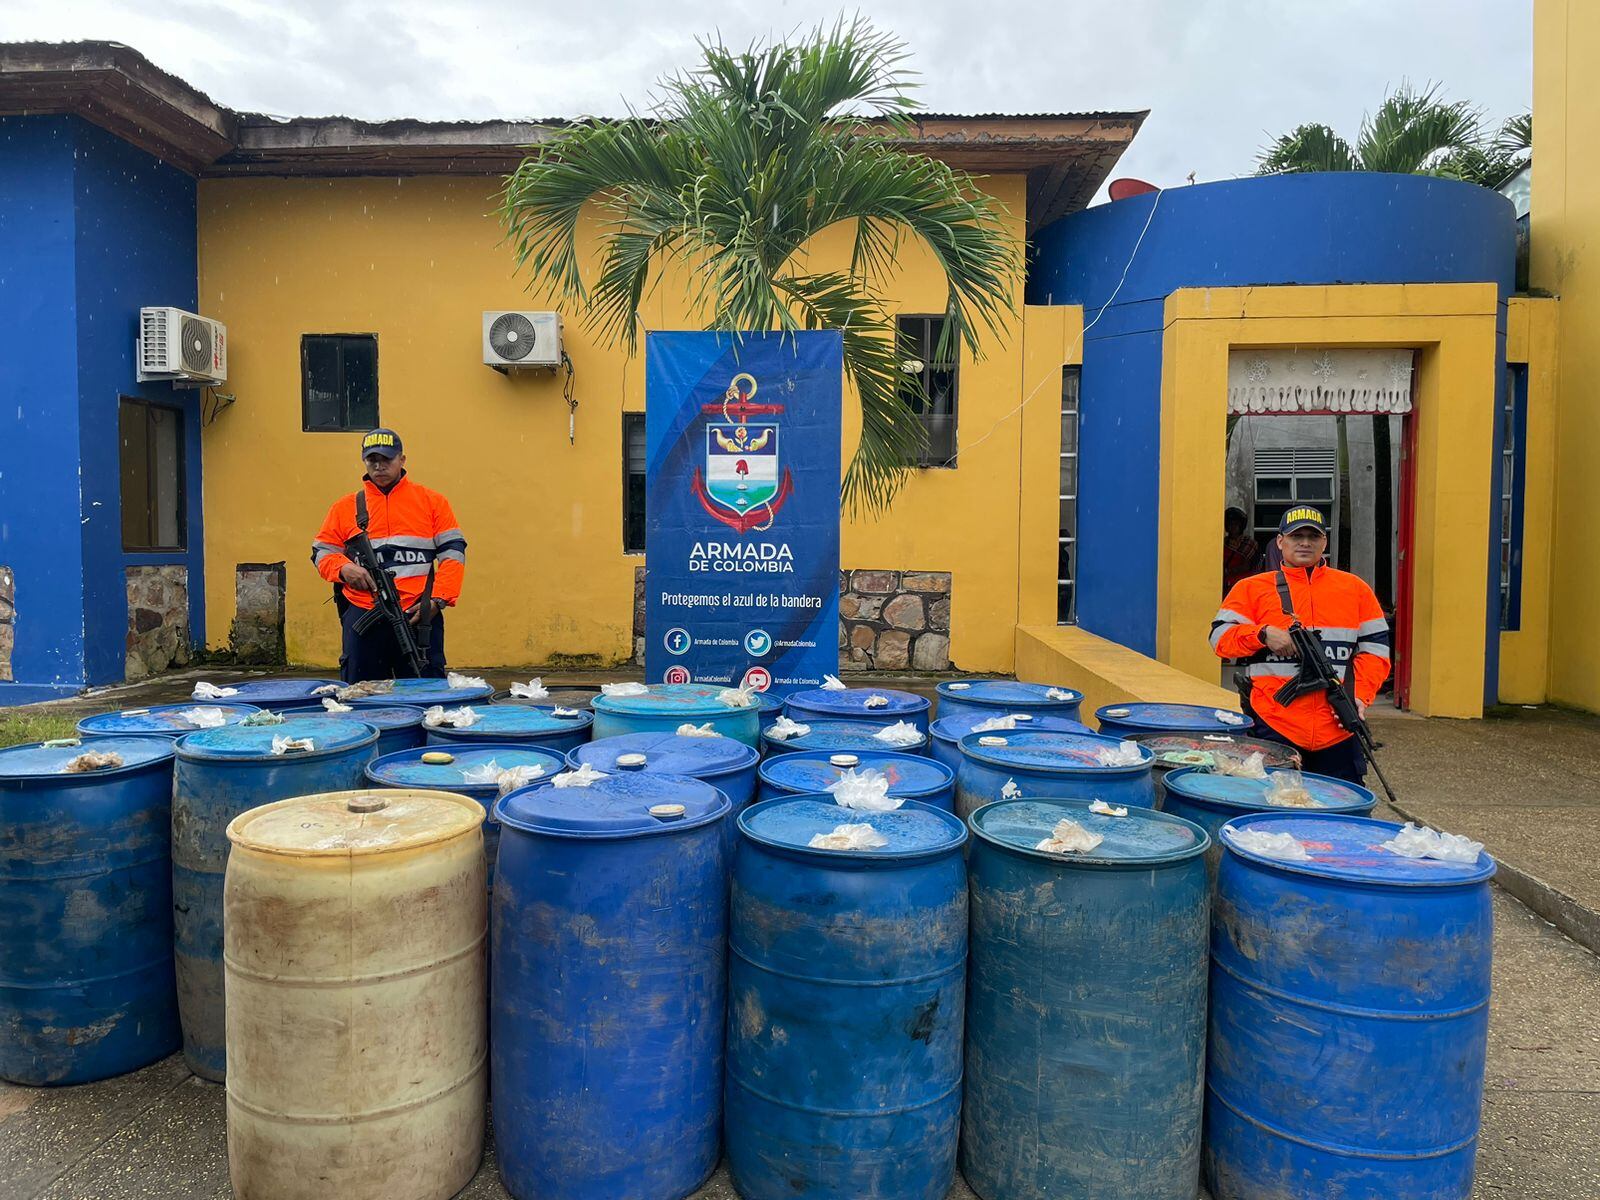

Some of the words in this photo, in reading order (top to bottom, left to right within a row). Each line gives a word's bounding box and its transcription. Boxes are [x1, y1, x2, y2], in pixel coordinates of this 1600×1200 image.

[364, 433, 394, 448] ARMADA
[1286, 508, 1322, 524] ARMADA
[689, 542, 794, 560] ARMADA
[689, 560, 709, 572] DE
[713, 560, 794, 573] COLOMBIA
[661, 592, 720, 608] Protegemos
[722, 593, 731, 606] el
[733, 593, 754, 607] azul
[756, 593, 768, 607] de
[770, 594, 779, 607] la
[781, 594, 822, 608] bandera
[694, 638, 711, 646] Armada
[712, 638, 718, 646] de
[718, 638, 739, 647] Colombia
[774, 677, 791, 685] Armada
[792, 677, 799, 685] de
[799, 677, 820, 686] Colombia
